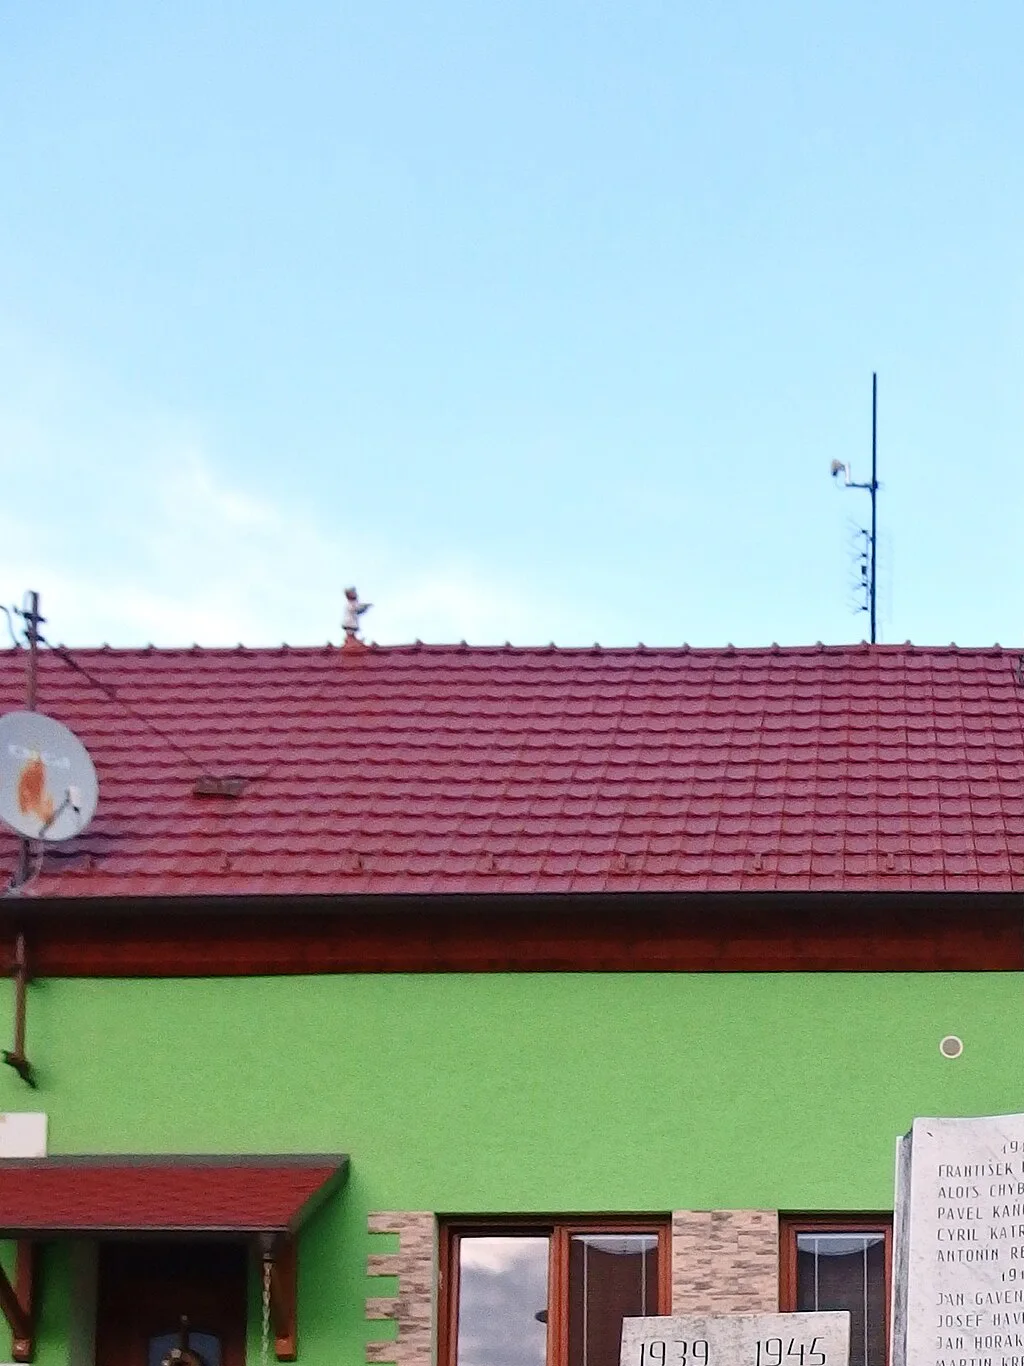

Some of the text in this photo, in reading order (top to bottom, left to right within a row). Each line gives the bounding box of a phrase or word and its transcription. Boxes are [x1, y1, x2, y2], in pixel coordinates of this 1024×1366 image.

[938, 1159, 1013, 1178] FRANTIŠEK
[938, 1186, 980, 1200] ALOIS
[937, 1206, 983, 1221] PAVEL
[937, 1228, 979, 1242] CYRIL
[937, 1244, 999, 1262] ANTONÍN
[936, 1293, 965, 1306] JAN
[936, 1314, 985, 1328] JOSEF
[936, 1336, 964, 1350] JAN
